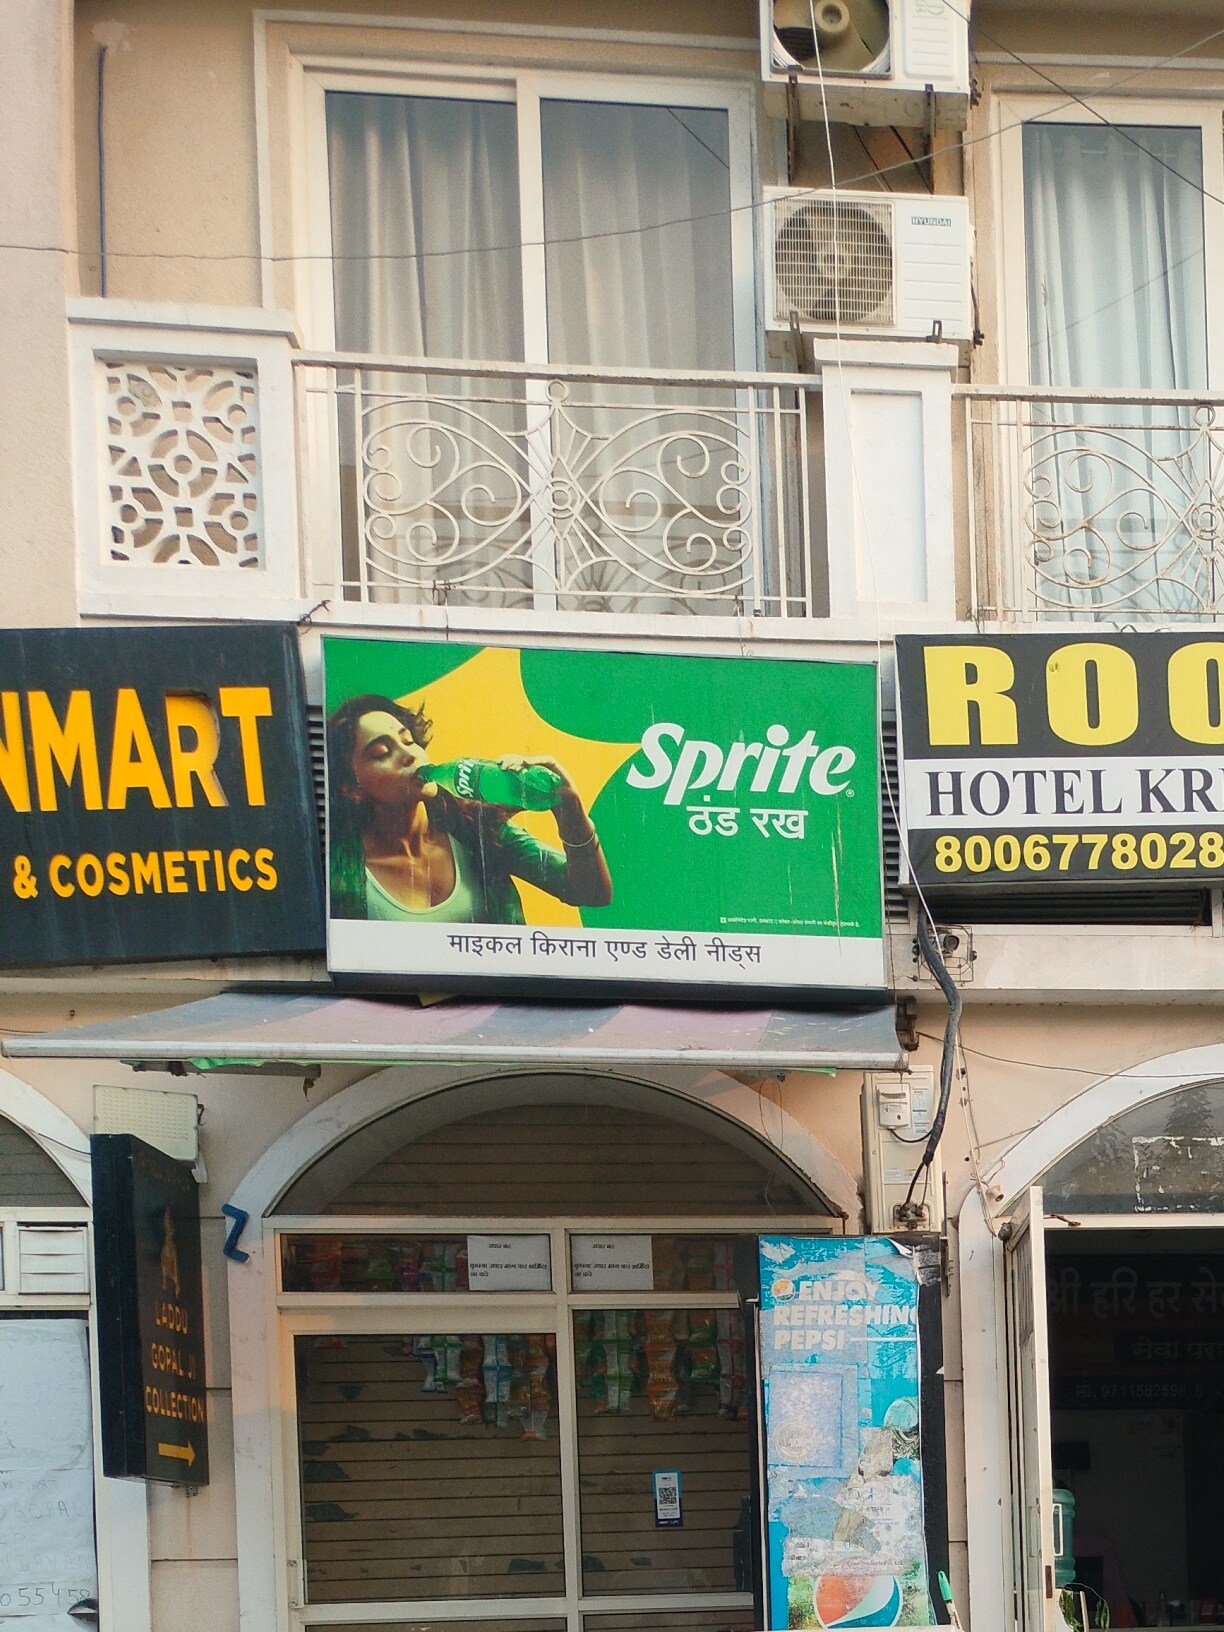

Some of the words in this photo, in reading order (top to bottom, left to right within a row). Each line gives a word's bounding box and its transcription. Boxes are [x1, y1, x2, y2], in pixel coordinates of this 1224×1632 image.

[911, 216, 951, 227] HYUNDAI
[626, 722, 856, 805] Sprite
[925, 769, 1122, 817] HOTEL
[687, 795, 739, 837] ठंड
[751, 806, 808, 839] रख
[13, 854, 39, 899] &
[50, 848, 278, 897] COSMETICS
[448, 931, 522, 956] माइकल
[532, 932, 597, 958] किराना
[607, 938, 648, 961] एण्ड
[655, 934, 697, 962] डेली
[706, 937, 762, 968] नीड्स
[800, 1280, 880, 1300] ENJOY
[155, 1300, 188, 1335] LADDU
[774, 1330, 845, 1350] PEPSI
[145, 1385, 205, 1423] COLLECTION
